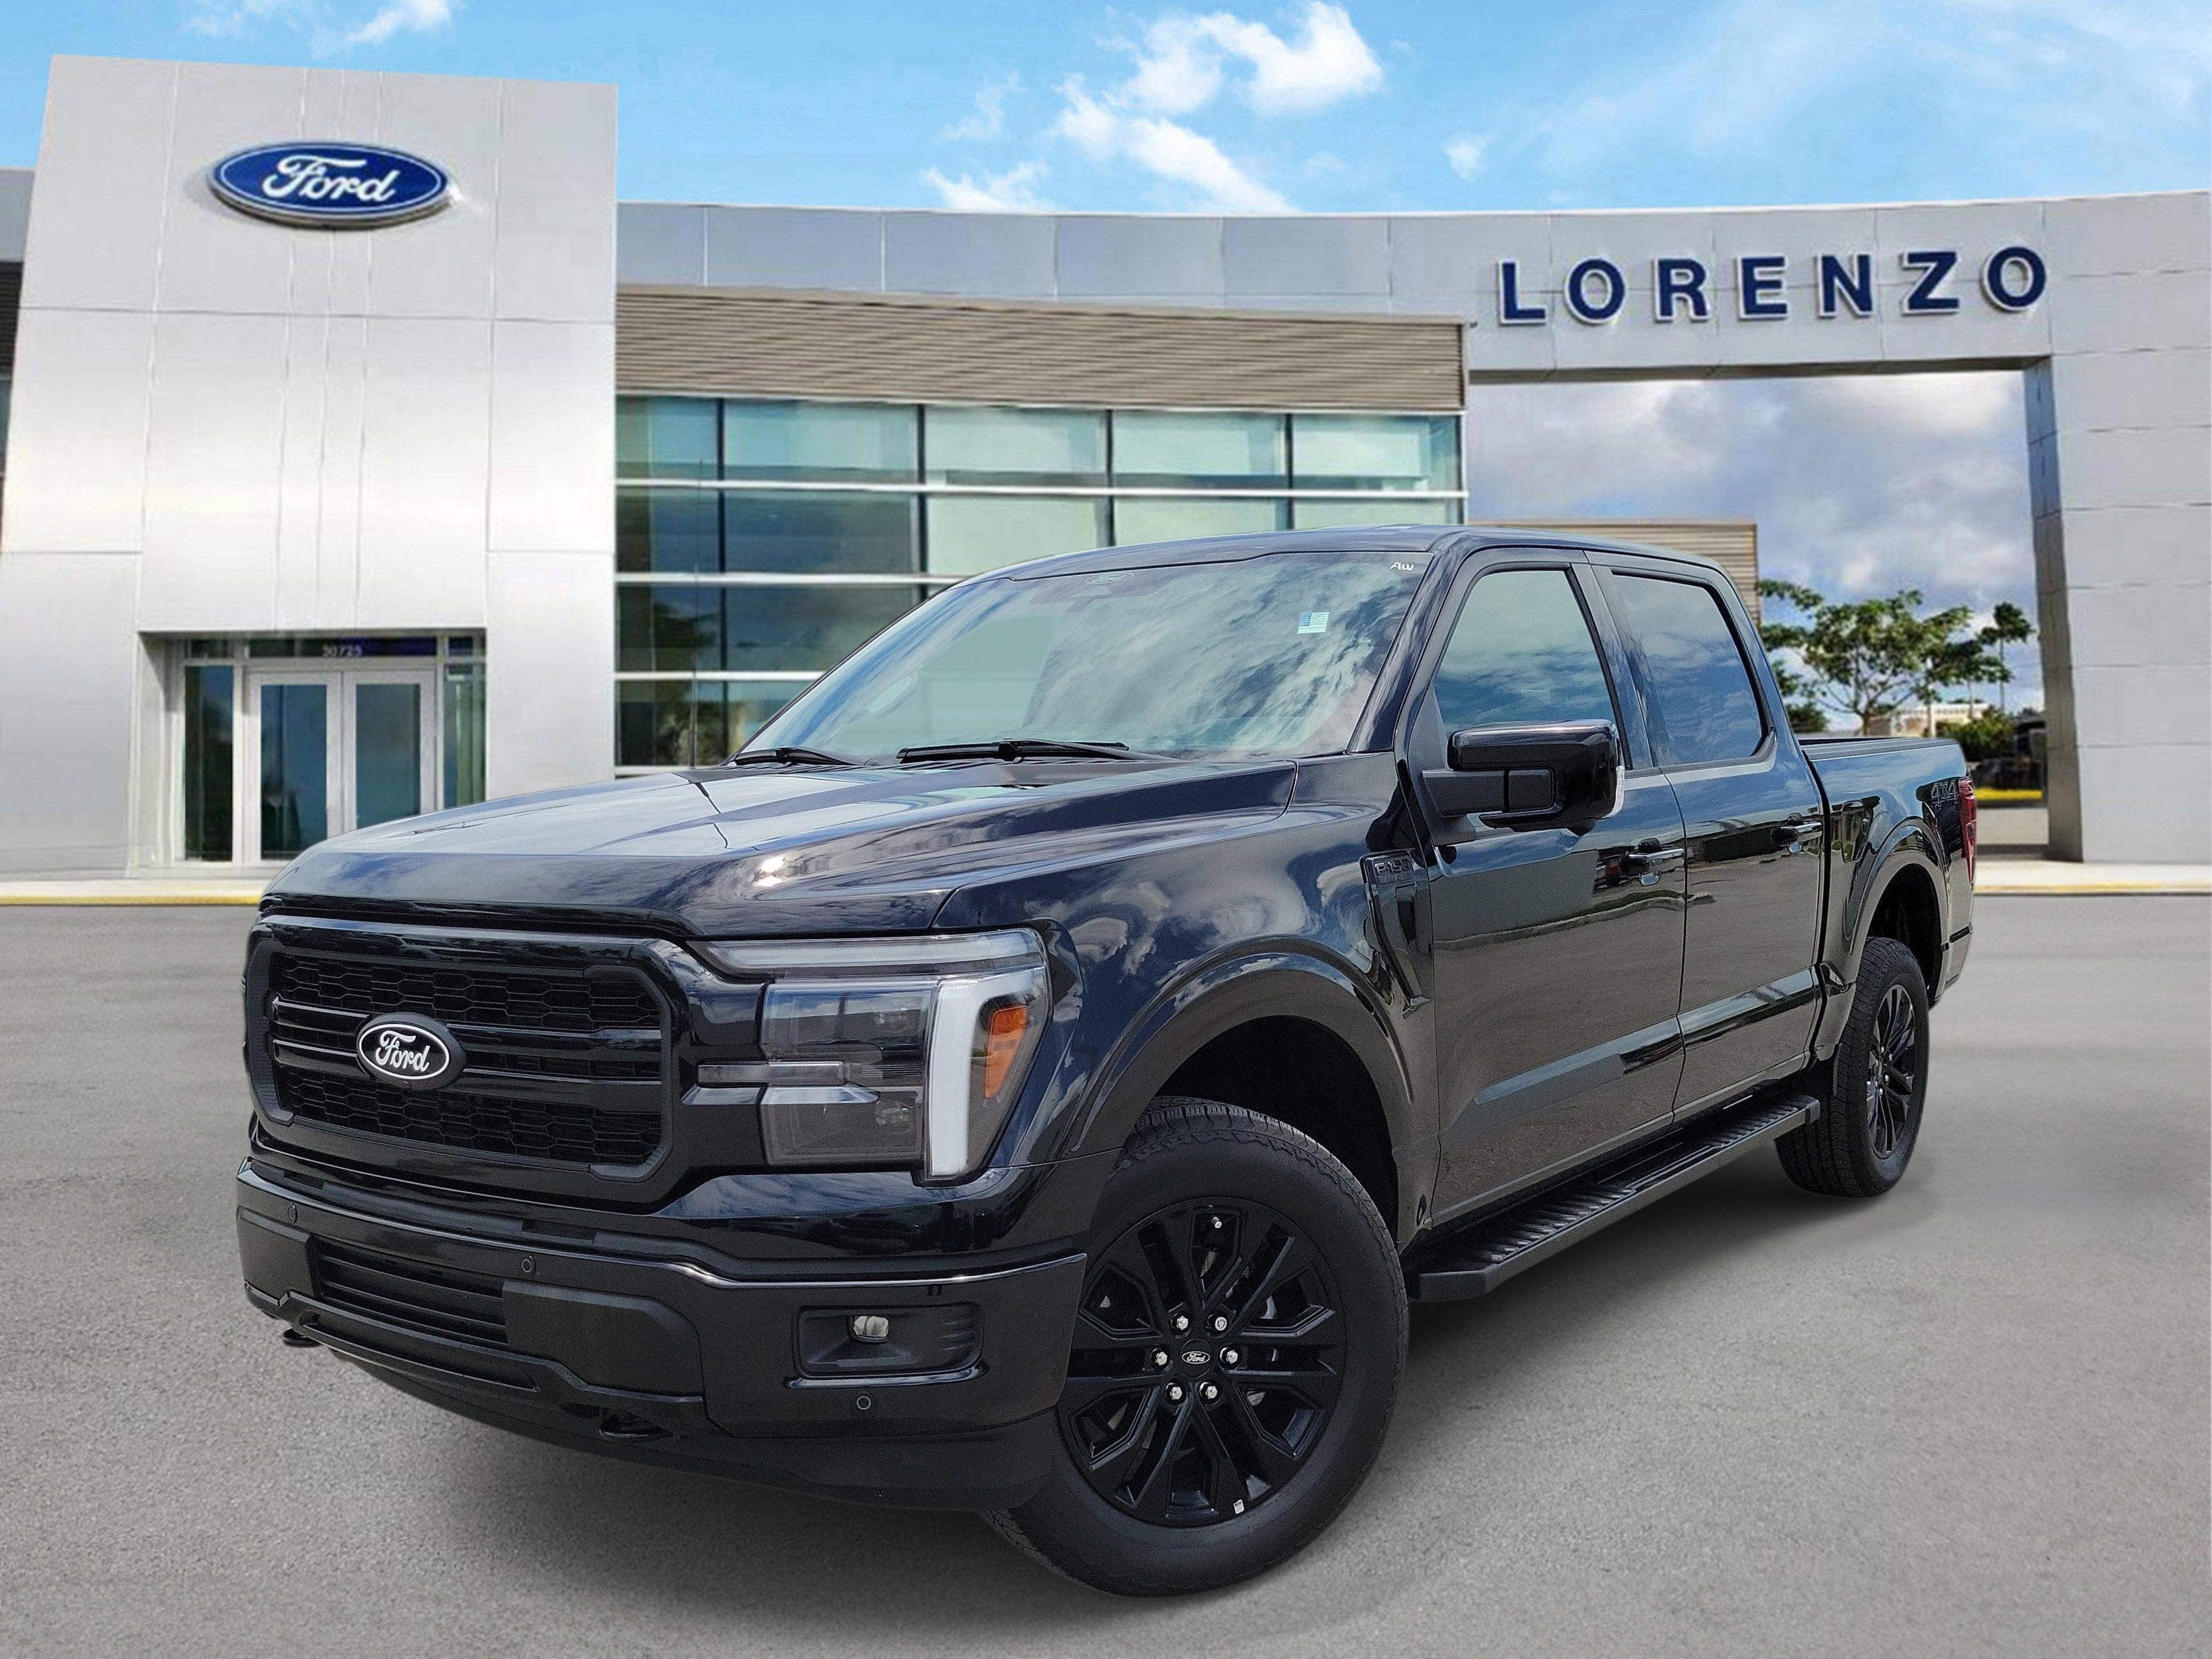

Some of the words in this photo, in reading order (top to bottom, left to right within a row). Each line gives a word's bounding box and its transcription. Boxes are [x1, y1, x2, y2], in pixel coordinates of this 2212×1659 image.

[262, 154, 400, 201] Ford
[1499, 246, 2047, 324] LORENZO
[1375, 859, 1411, 876] F-150
[375, 1030, 430, 1072] Ford
[1187, 1353, 1206, 1362] Ford
